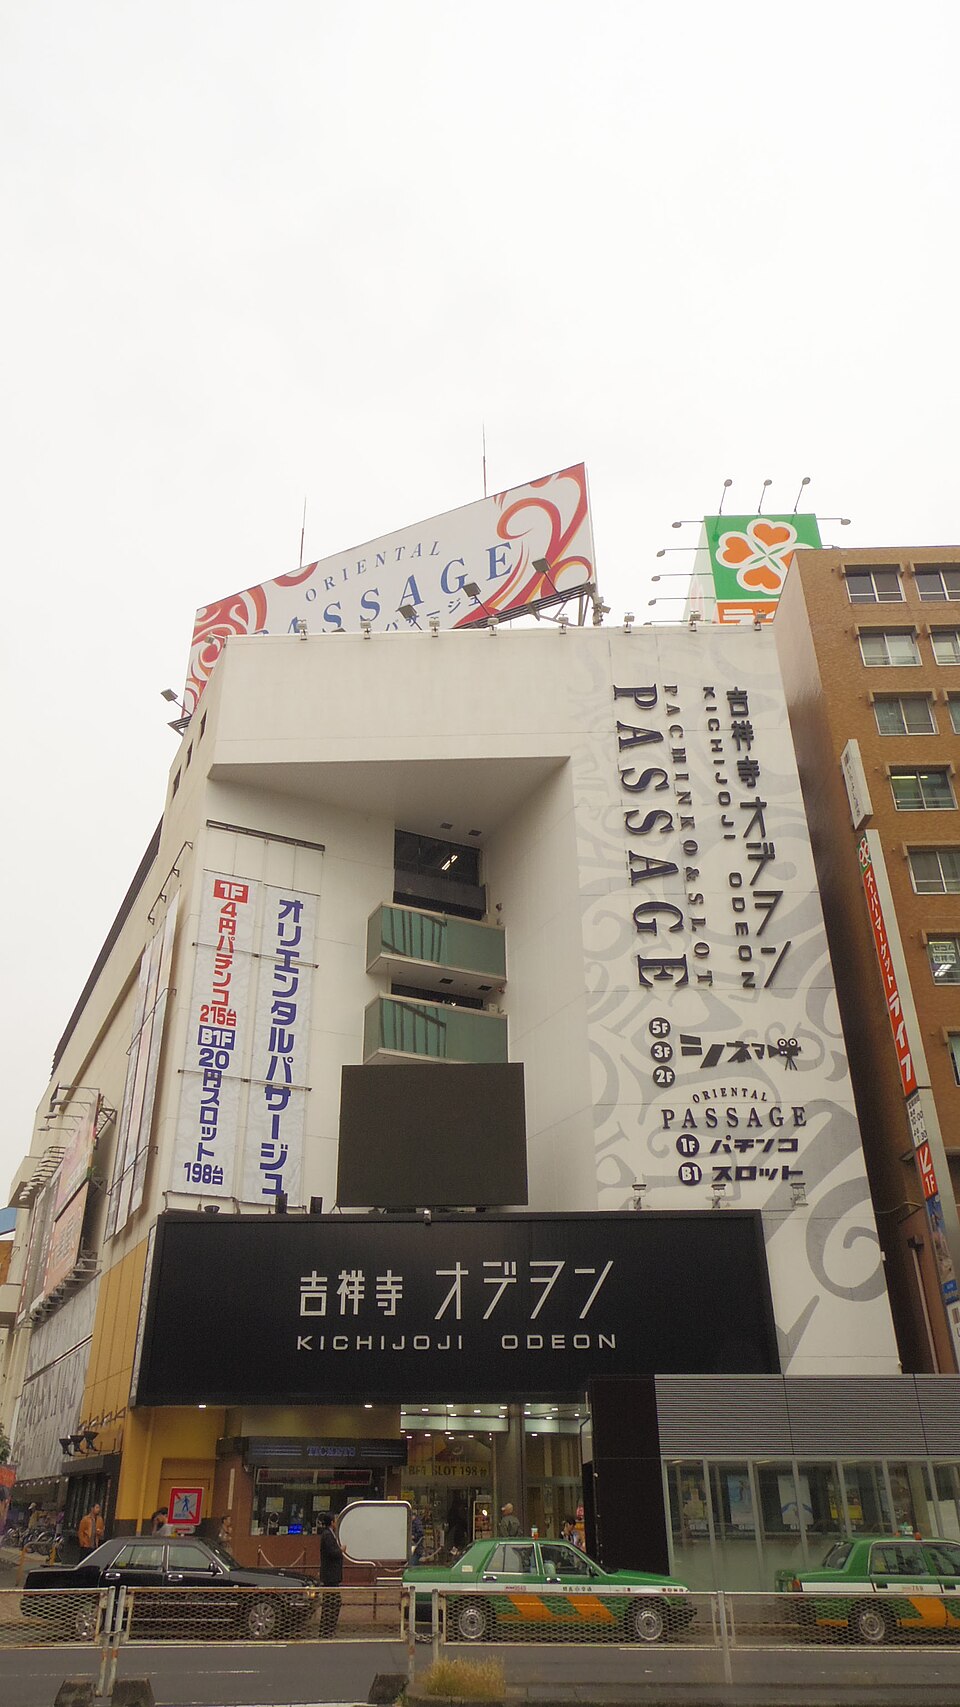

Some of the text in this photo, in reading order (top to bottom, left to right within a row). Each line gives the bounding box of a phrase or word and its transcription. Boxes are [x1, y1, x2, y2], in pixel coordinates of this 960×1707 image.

[305, 541, 440, 602] ORIENTAL
[613, 683, 689, 988] PASSAGE
[663, 684, 713, 987] PACHINKO & SLOT
[703, 686, 756, 988] KICHIJOJI ODEON
[219, 883, 245, 900] 1F
[199, 1004, 237, 1027] 215台
[200, 1029, 234, 1047] B1F
[651, 1021, 668, 1034] 5F
[888, 991, 910, 1082] ライフ
[259, 899, 304, 1195] オリエンタルパサージュ
[653, 1045, 671, 1058] 3F
[679, 1034, 766, 1069] シネマ
[655, 1069, 673, 1083] 2F
[692, 1087, 768, 1103] ORIENTAL
[661, 1106, 807, 1129] PASSAGE
[681, 1135, 799, 1154] 1F パチンコ
[184, 1162, 224, 1186] 198台
[680, 1165, 804, 1181] B1 スロット
[924, 1173, 935, 1195] 1F
[296, 1334, 617, 1350] KICHIJOJI ODEON
